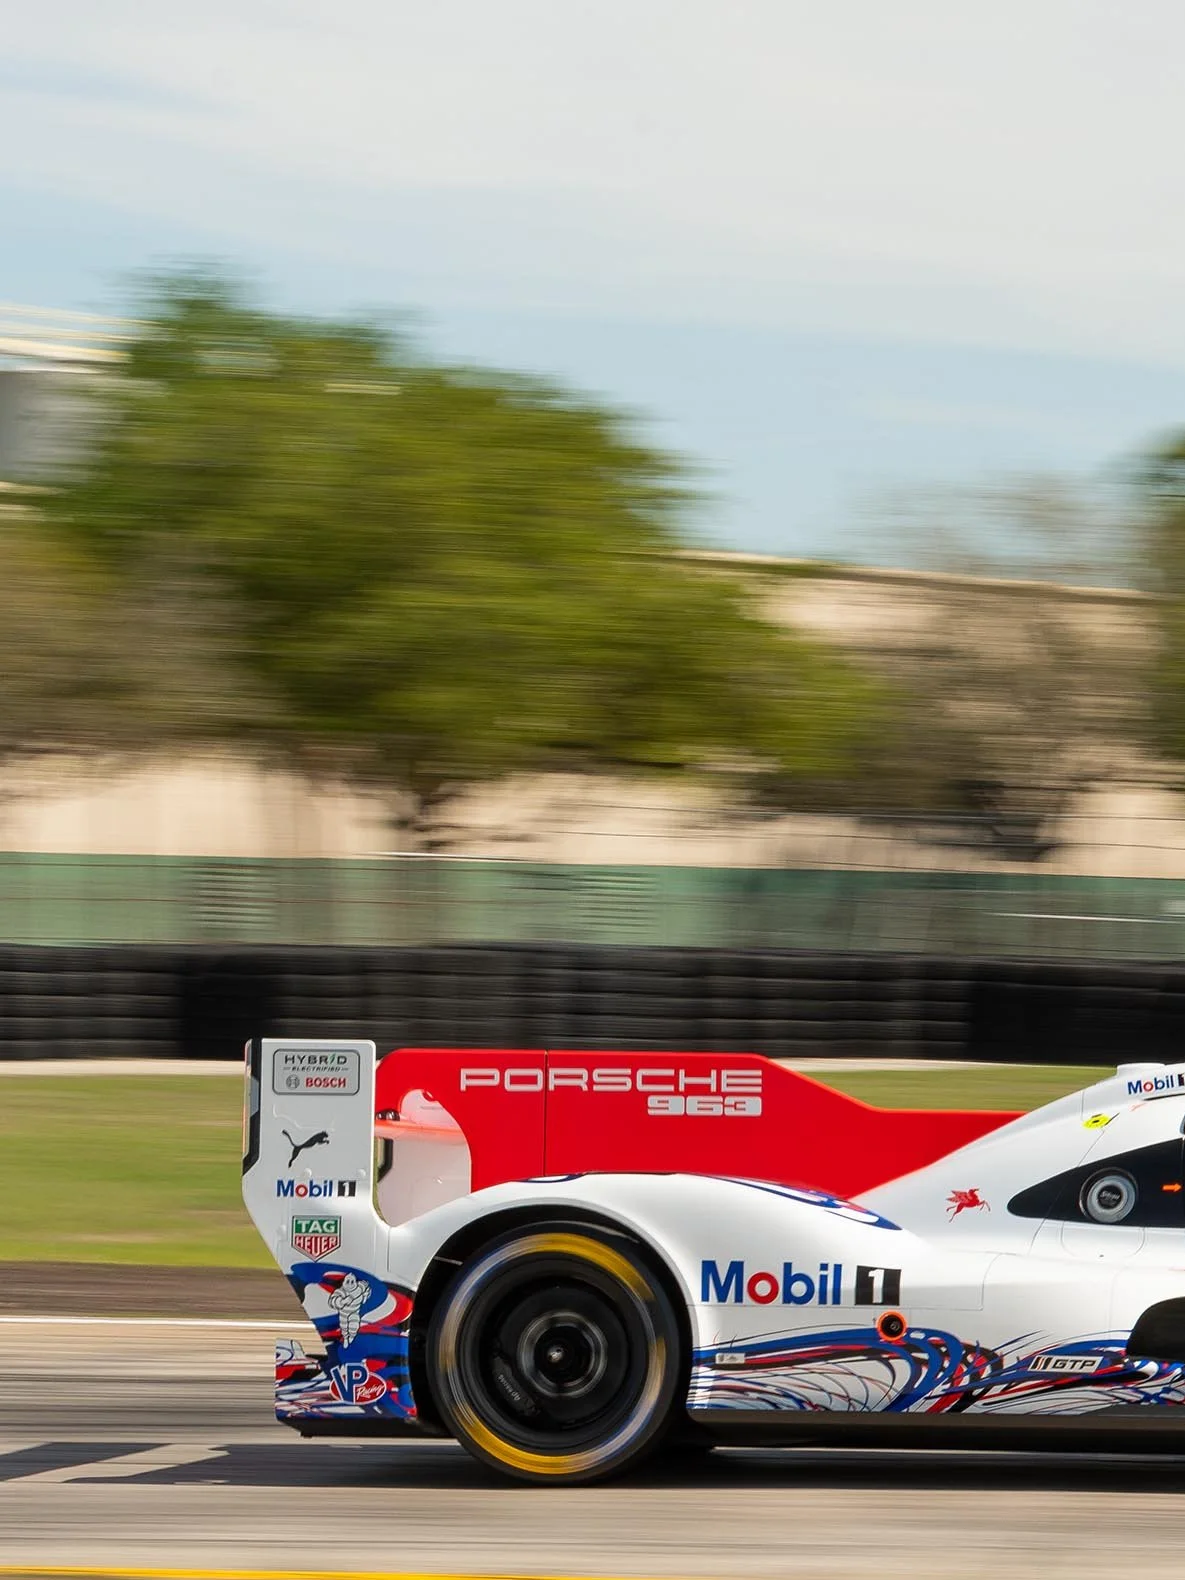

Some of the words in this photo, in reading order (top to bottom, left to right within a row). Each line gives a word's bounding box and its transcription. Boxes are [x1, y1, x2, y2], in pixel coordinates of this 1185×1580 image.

[305, 1077, 347, 1088] BOSCH
[460, 1068, 763, 1092] PORSCHE
[1127, 1075, 1175, 1095] Mobil
[647, 1096, 763, 1116] 963
[276, 1180, 334, 1198] Mobil
[297, 1220, 336, 1233] TAG
[295, 1235, 337, 1257] HEUER
[701, 1260, 842, 1305] Mobil
[1052, 1360, 1097, 1370] GTP
[331, 1363, 368, 1404] VP
